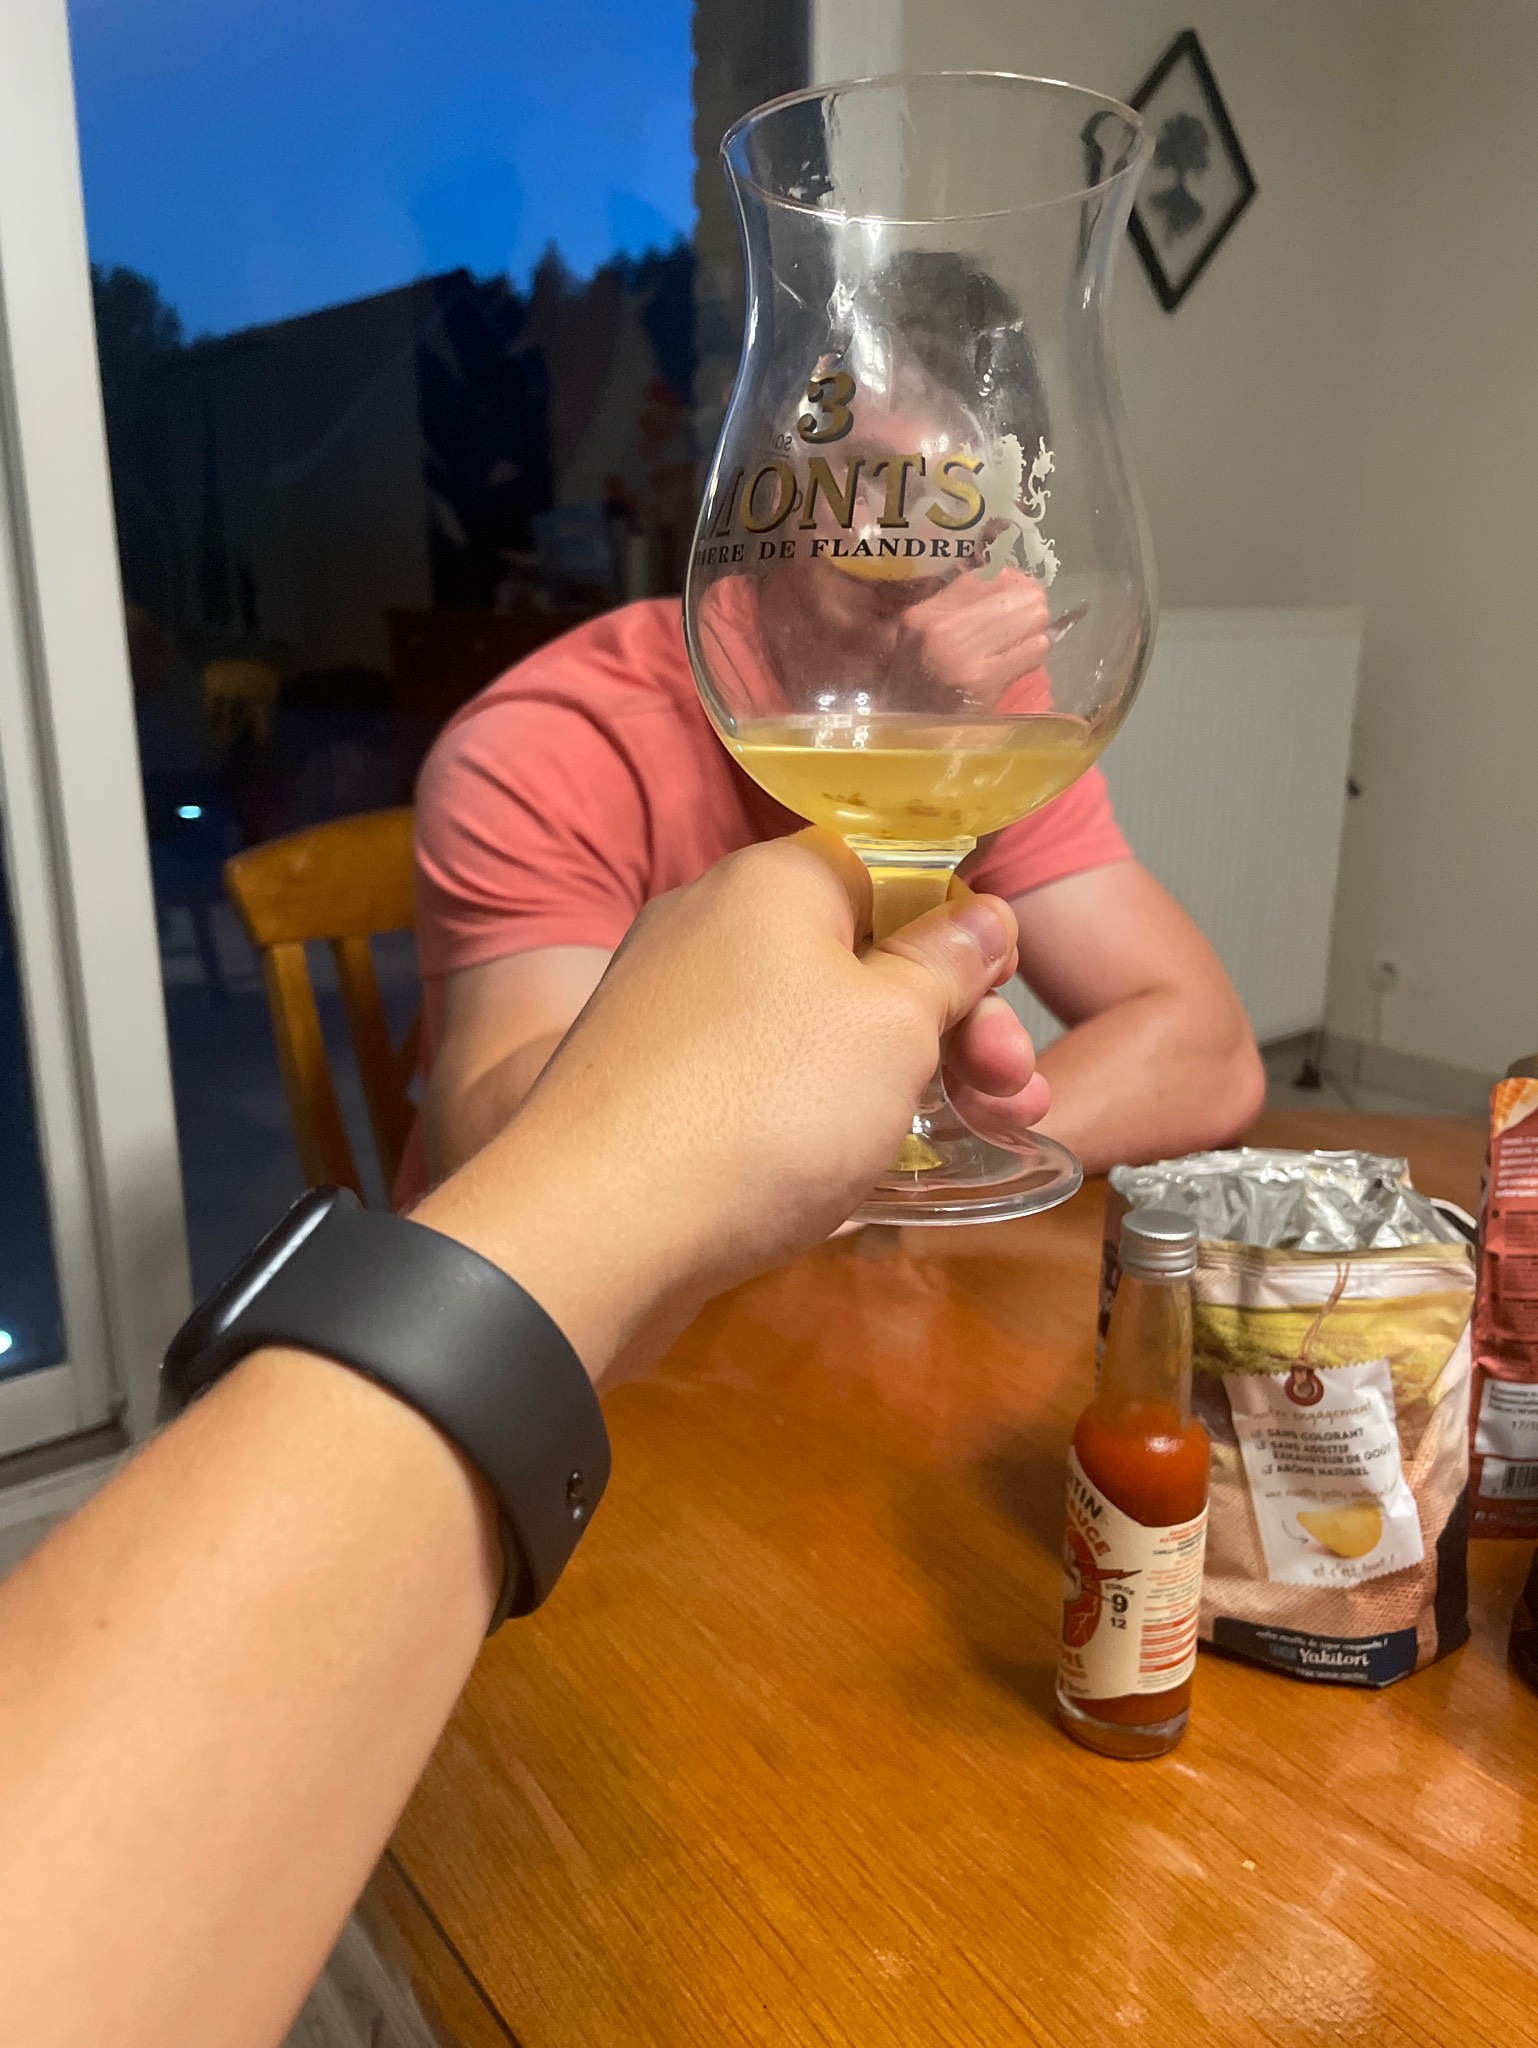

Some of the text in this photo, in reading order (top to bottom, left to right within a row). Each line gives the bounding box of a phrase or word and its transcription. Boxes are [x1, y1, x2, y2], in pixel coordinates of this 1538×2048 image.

[797, 371, 856, 444] 3
[759, 540, 796, 560] DE
[810, 538, 975, 558] FLANDRE
[1301, 1428, 1364, 1441] COLORANT
[1112, 1594, 1129, 1613] 9
[1110, 1617, 1127, 1630] 12
[1299, 1647, 1370, 1668] Yakitori
